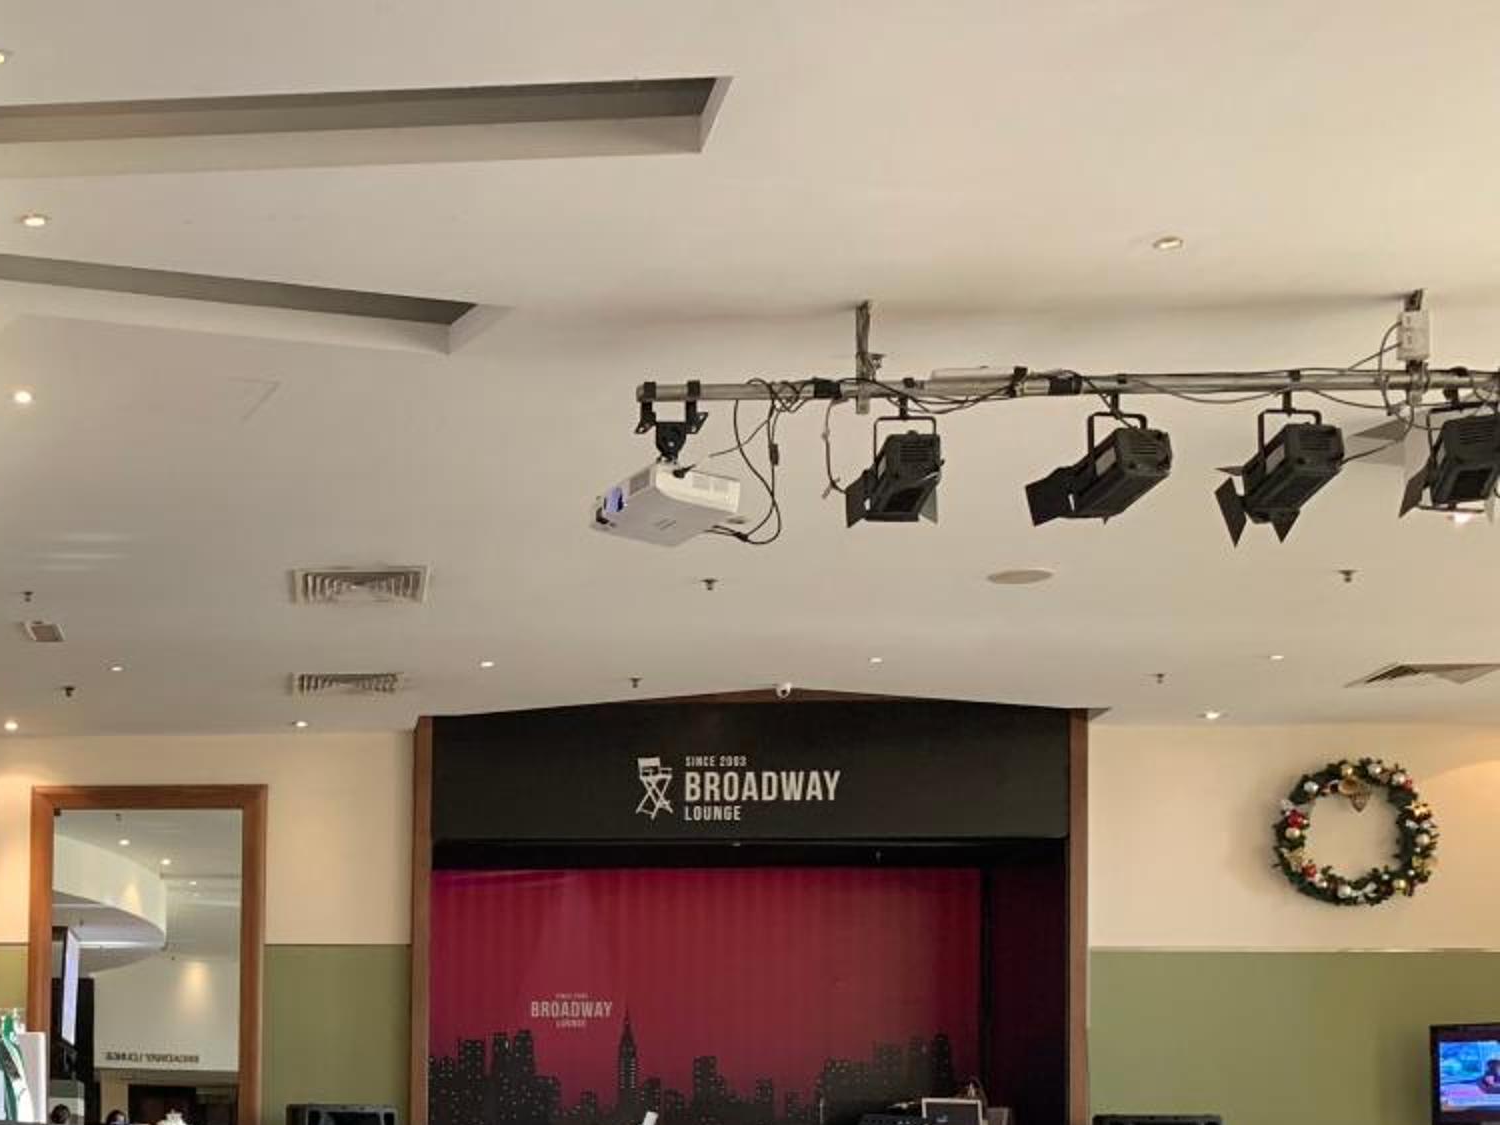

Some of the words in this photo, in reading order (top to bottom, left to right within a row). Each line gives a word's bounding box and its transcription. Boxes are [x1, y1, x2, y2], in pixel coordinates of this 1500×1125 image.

[685, 756, 714, 766] SINCE
[685, 770, 840, 801] BROADWAY
[684, 806, 741, 820] LOUNGE
[531, 1001, 612, 1017] BROADWAY
